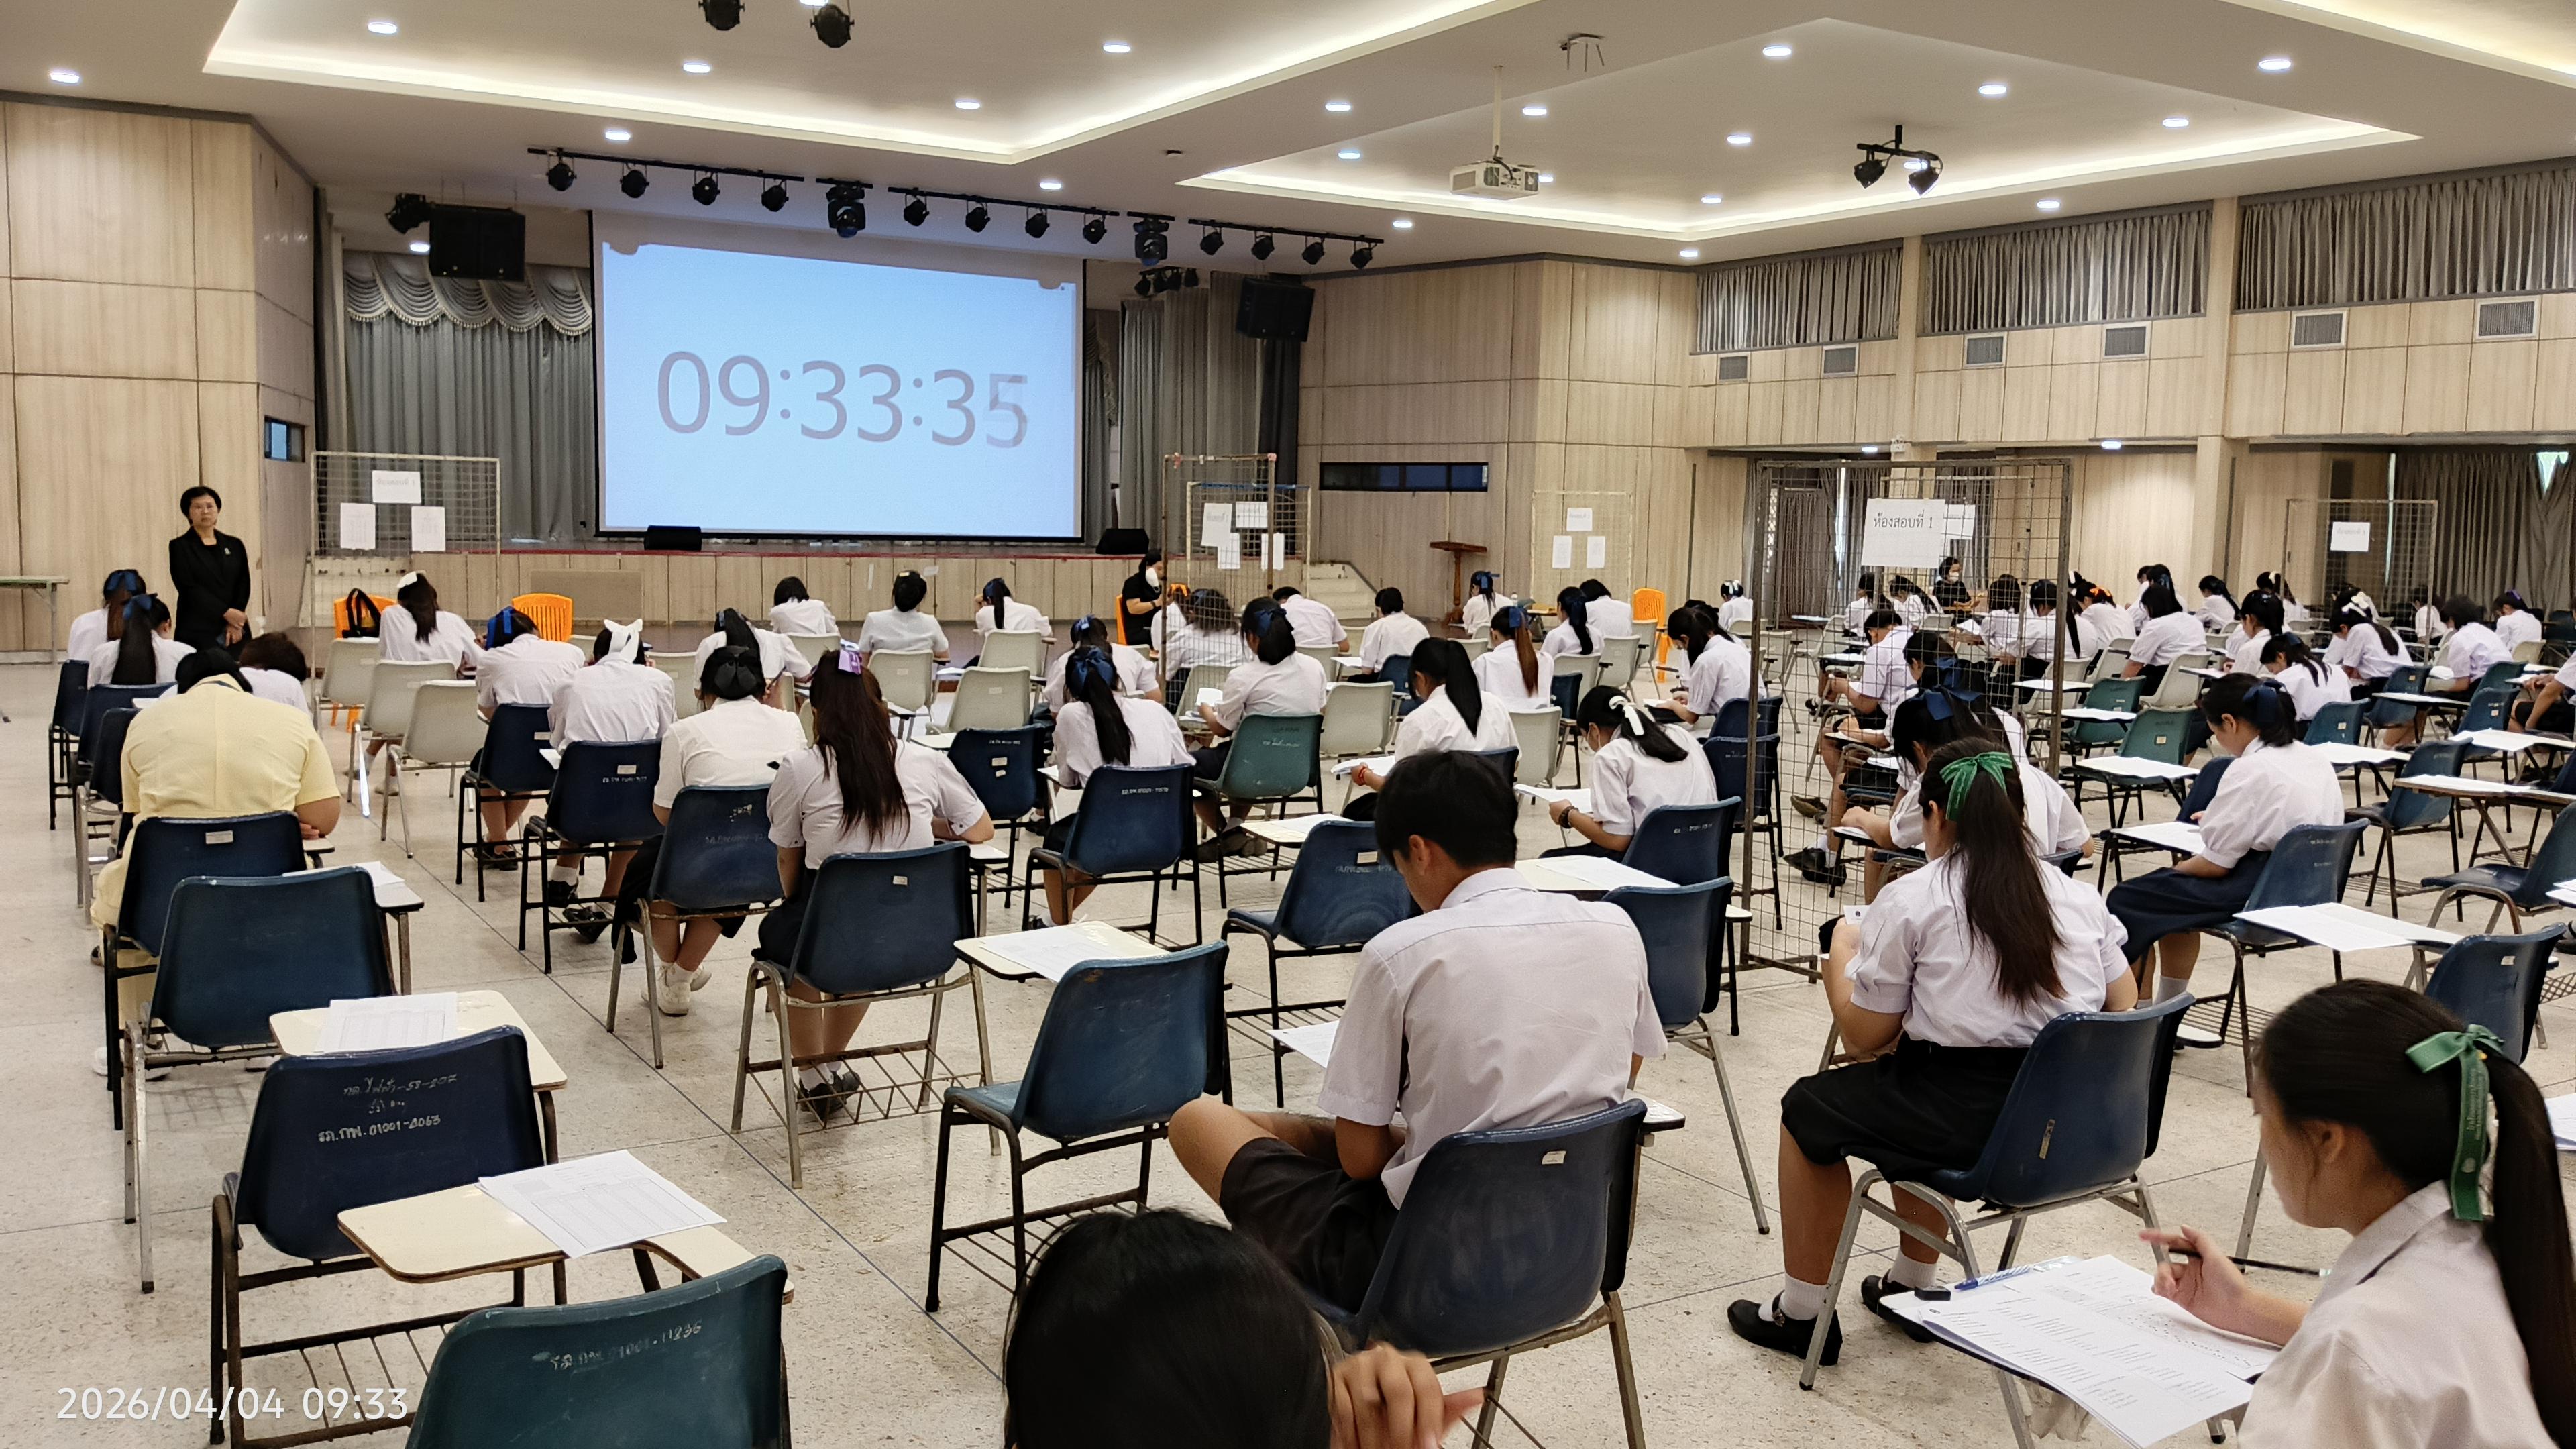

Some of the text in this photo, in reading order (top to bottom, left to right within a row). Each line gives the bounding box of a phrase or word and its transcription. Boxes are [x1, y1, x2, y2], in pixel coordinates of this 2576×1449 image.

[658, 351, 1028, 448] 09:33:35
[1874, 510, 1933, 528] ห้องสอบที่ 1
